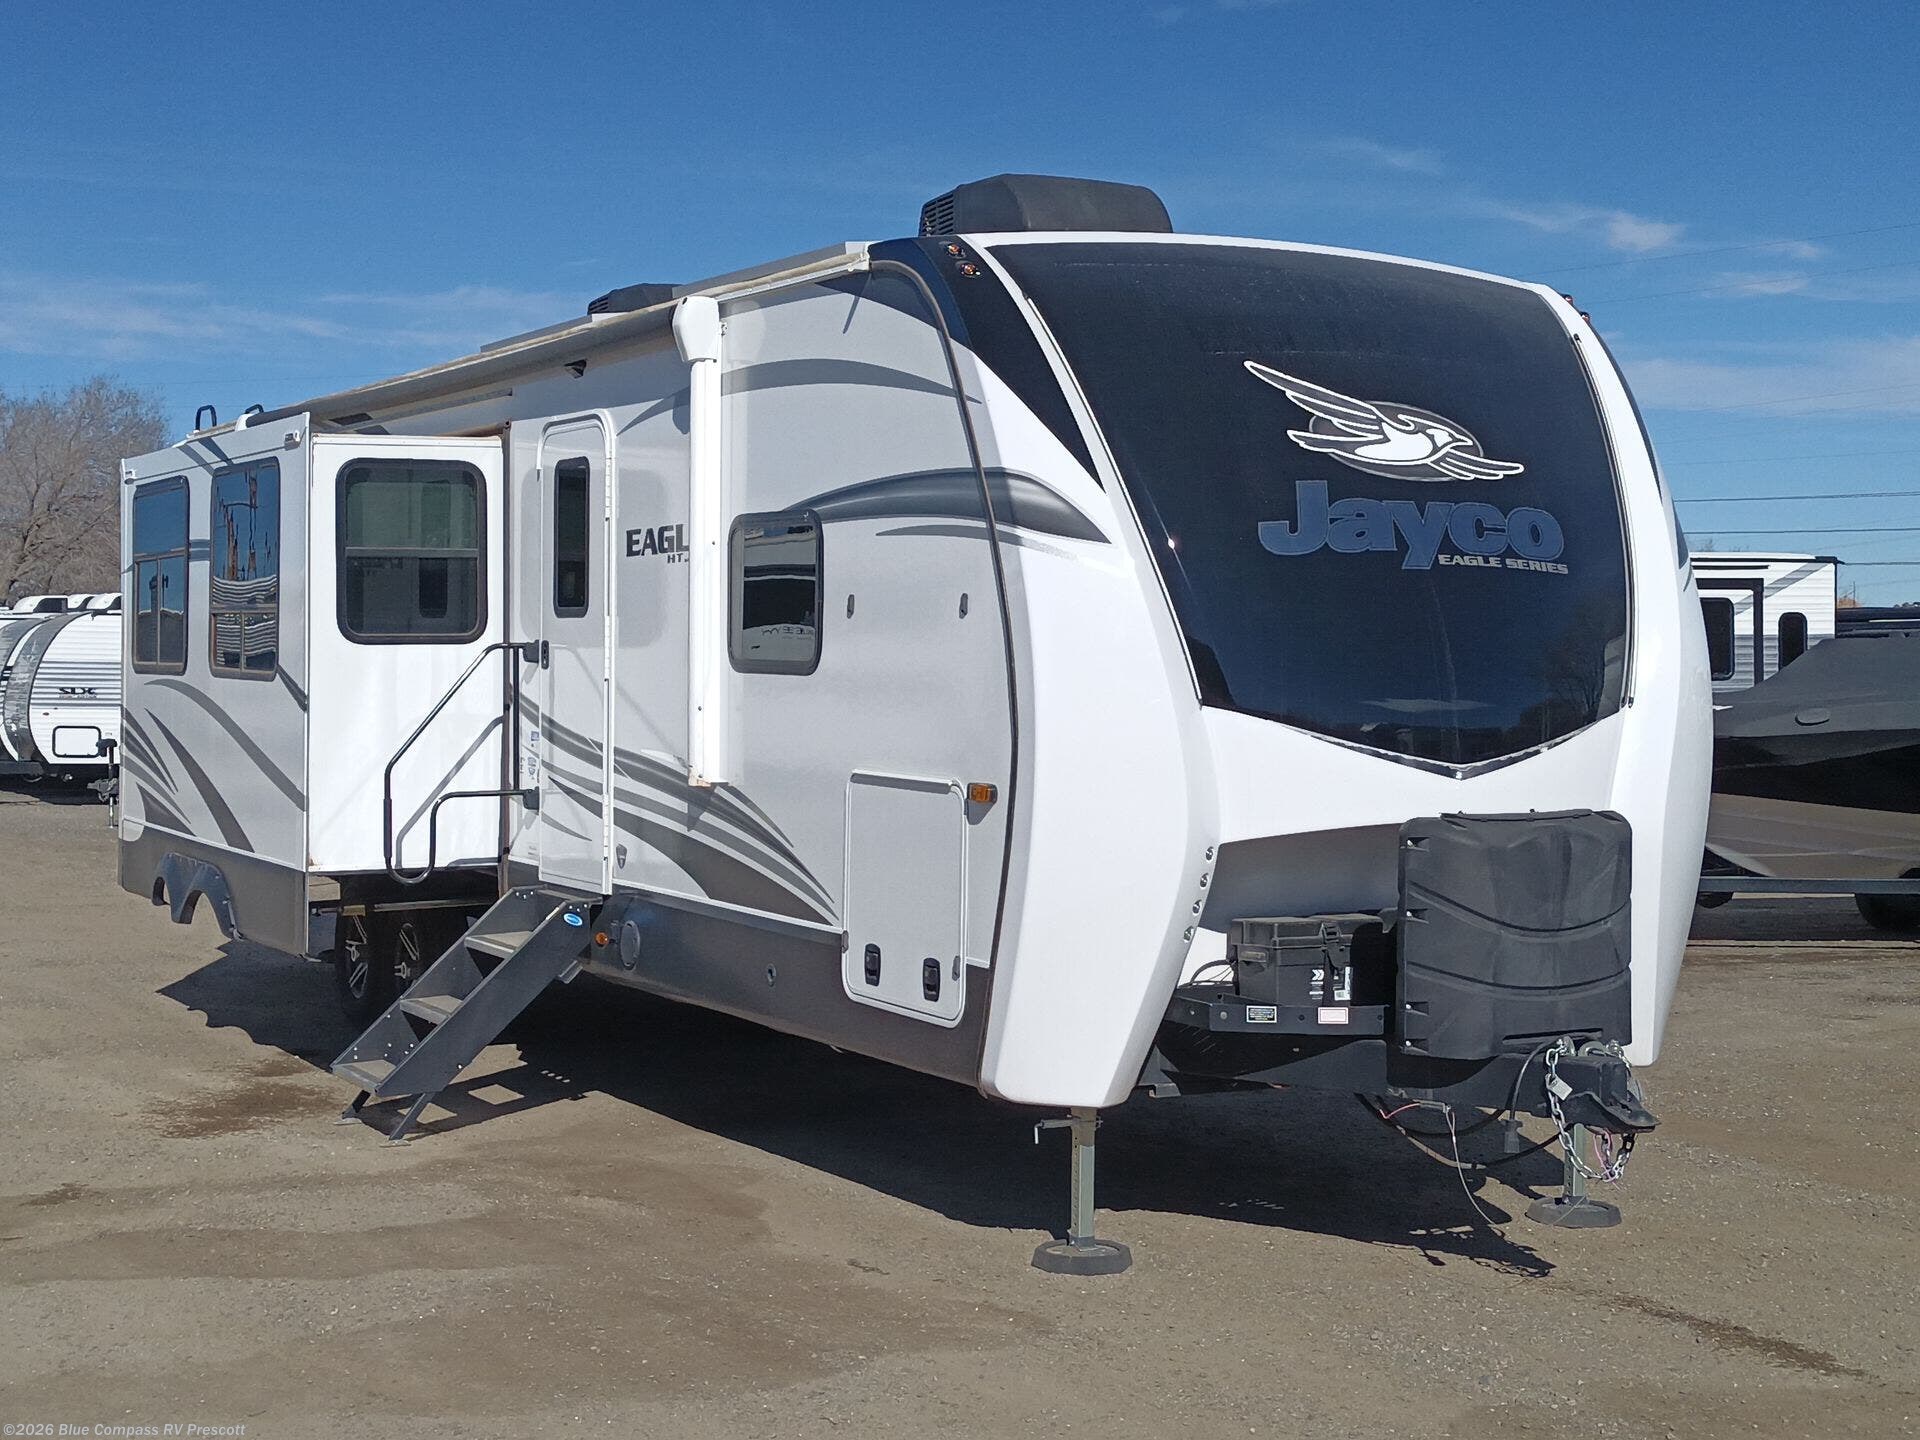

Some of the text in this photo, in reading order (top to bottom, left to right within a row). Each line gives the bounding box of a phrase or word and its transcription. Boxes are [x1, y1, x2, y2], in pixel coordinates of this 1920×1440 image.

[626, 523, 690, 557] EAGL
[1258, 480, 1565, 570] Jayco
[1438, 554, 1568, 574] EAGLE SERIES
